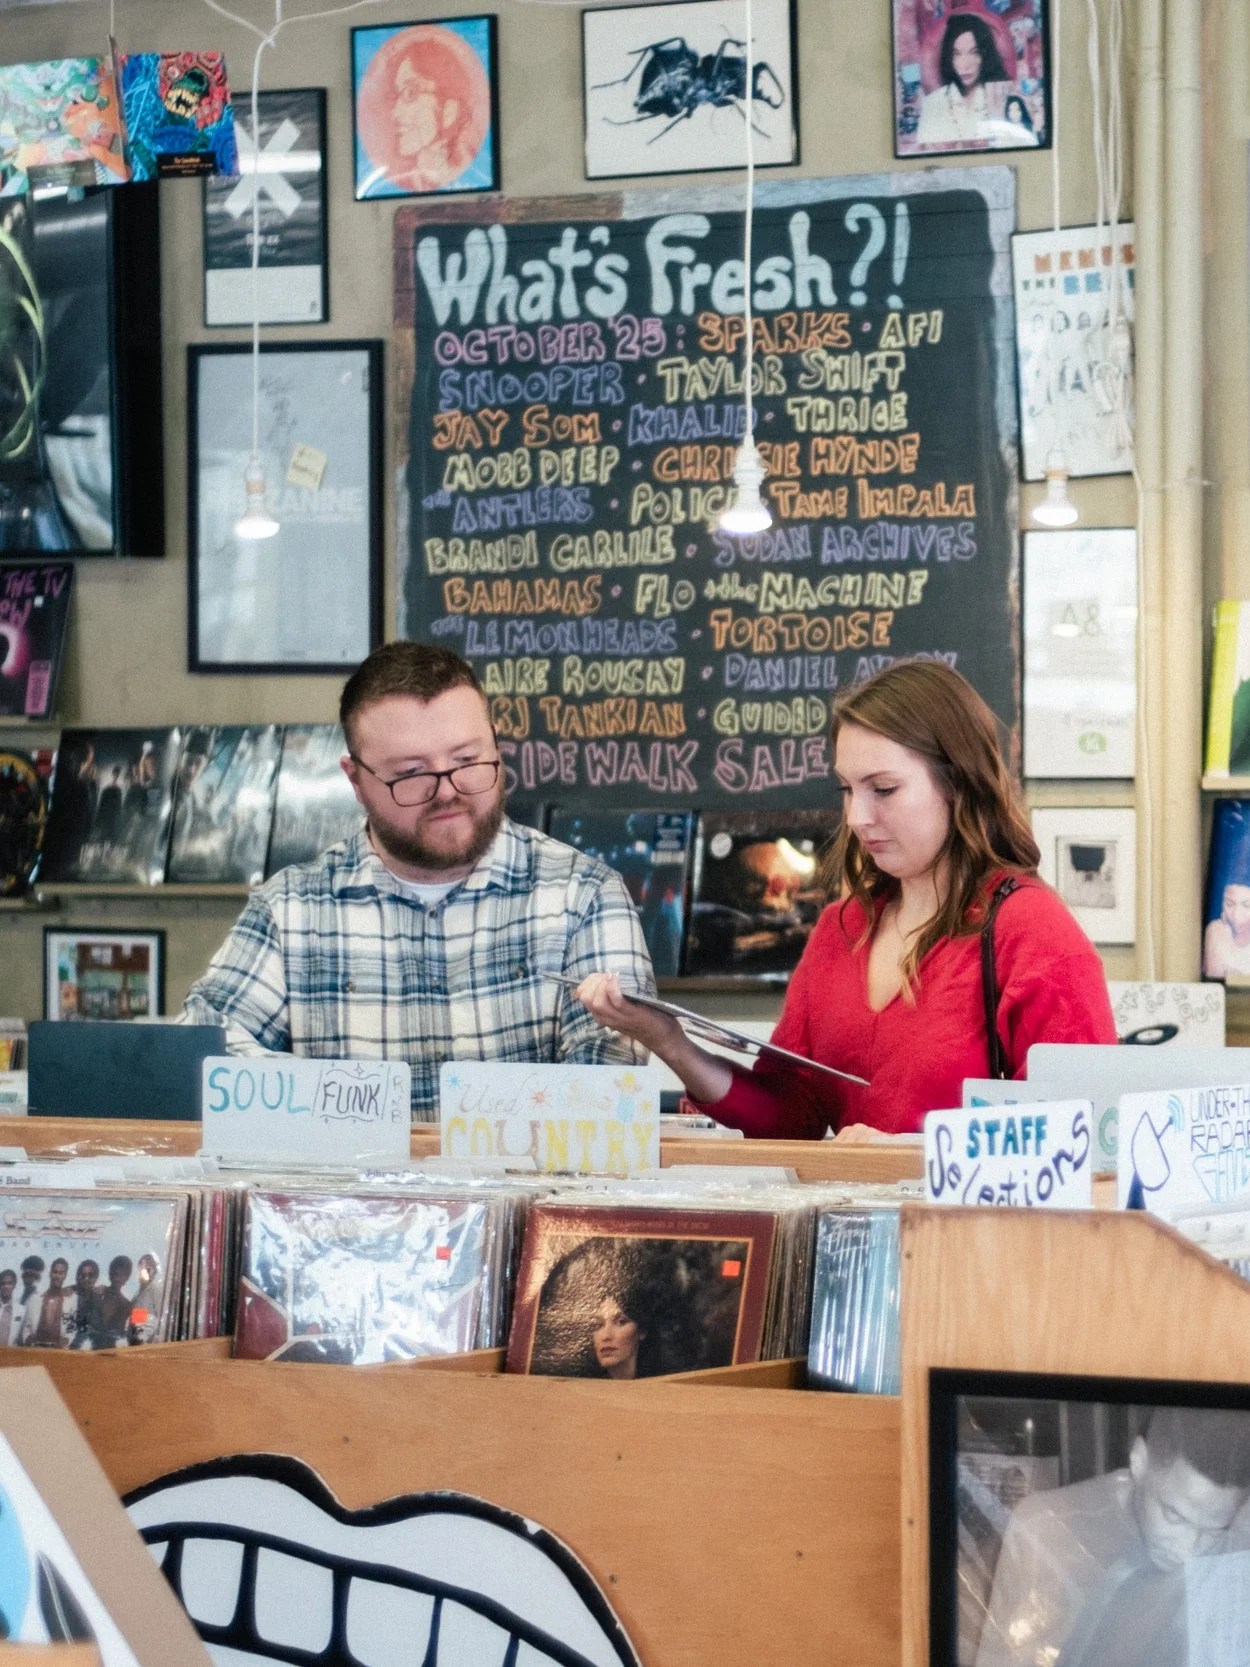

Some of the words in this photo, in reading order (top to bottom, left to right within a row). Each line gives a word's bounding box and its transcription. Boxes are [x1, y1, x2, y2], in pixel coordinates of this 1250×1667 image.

[416, 222, 630, 326] What's
[434, 322, 606, 366] OCTOBER
[698, 311, 851, 353] SPARKS
[880, 310, 943, 348] AFI
[439, 361, 625, 412] SNOOPER
[657, 354, 787, 402] TAYLOR
[799, 348, 906, 392] SWIFT
[432, 407, 510, 450] JAY
[522, 403, 603, 447] SOM
[628, 402, 758, 446] KHALID
[787, 391, 908, 432] THRICE
[443, 447, 532, 492] MOBB
[540, 445, 620, 487] DEEP
[653, 441, 801, 482] CHRISIE
[811, 432, 921, 476] HYNDE
[453, 485, 594, 534] ANTLERS
[631, 482, 742, 534] POLIÇ
[769, 481, 849, 519] TAME
[856, 477, 976, 519] IMPALA
[424, 530, 539, 575] BRANDI
[550, 524, 677, 572] CARLILE
[713, 522, 812, 567] SUDAN
[820, 520, 978, 565] ARCHIVES
[41, 567, 68, 598] TV
[443, 575, 602, 616] BAHAMAS
[635, 573, 697, 618] FLO
[759, 568, 929, 613] MACHINE
[464, 615, 679, 656] LEMONHEADS
[709, 607, 894, 653] TORTOISE
[468, 656, 551, 695] AIRE
[563, 654, 686, 697] ROUSAY
[724, 652, 839, 692] DANIEL
[490, 695, 531, 739] RJ
[539, 695, 687, 738] TANKIAN
[713, 695, 827, 736] GUIDED
[713, 736, 830, 793] SALE
[208, 1066, 311, 1114] SOUL
[321, 1080, 382, 1117] FUNK
[447, 1116, 654, 1173] COUNTRY
[966, 1114, 1048, 1159] STAFF
[6, 1175, 31, 1186] Band
